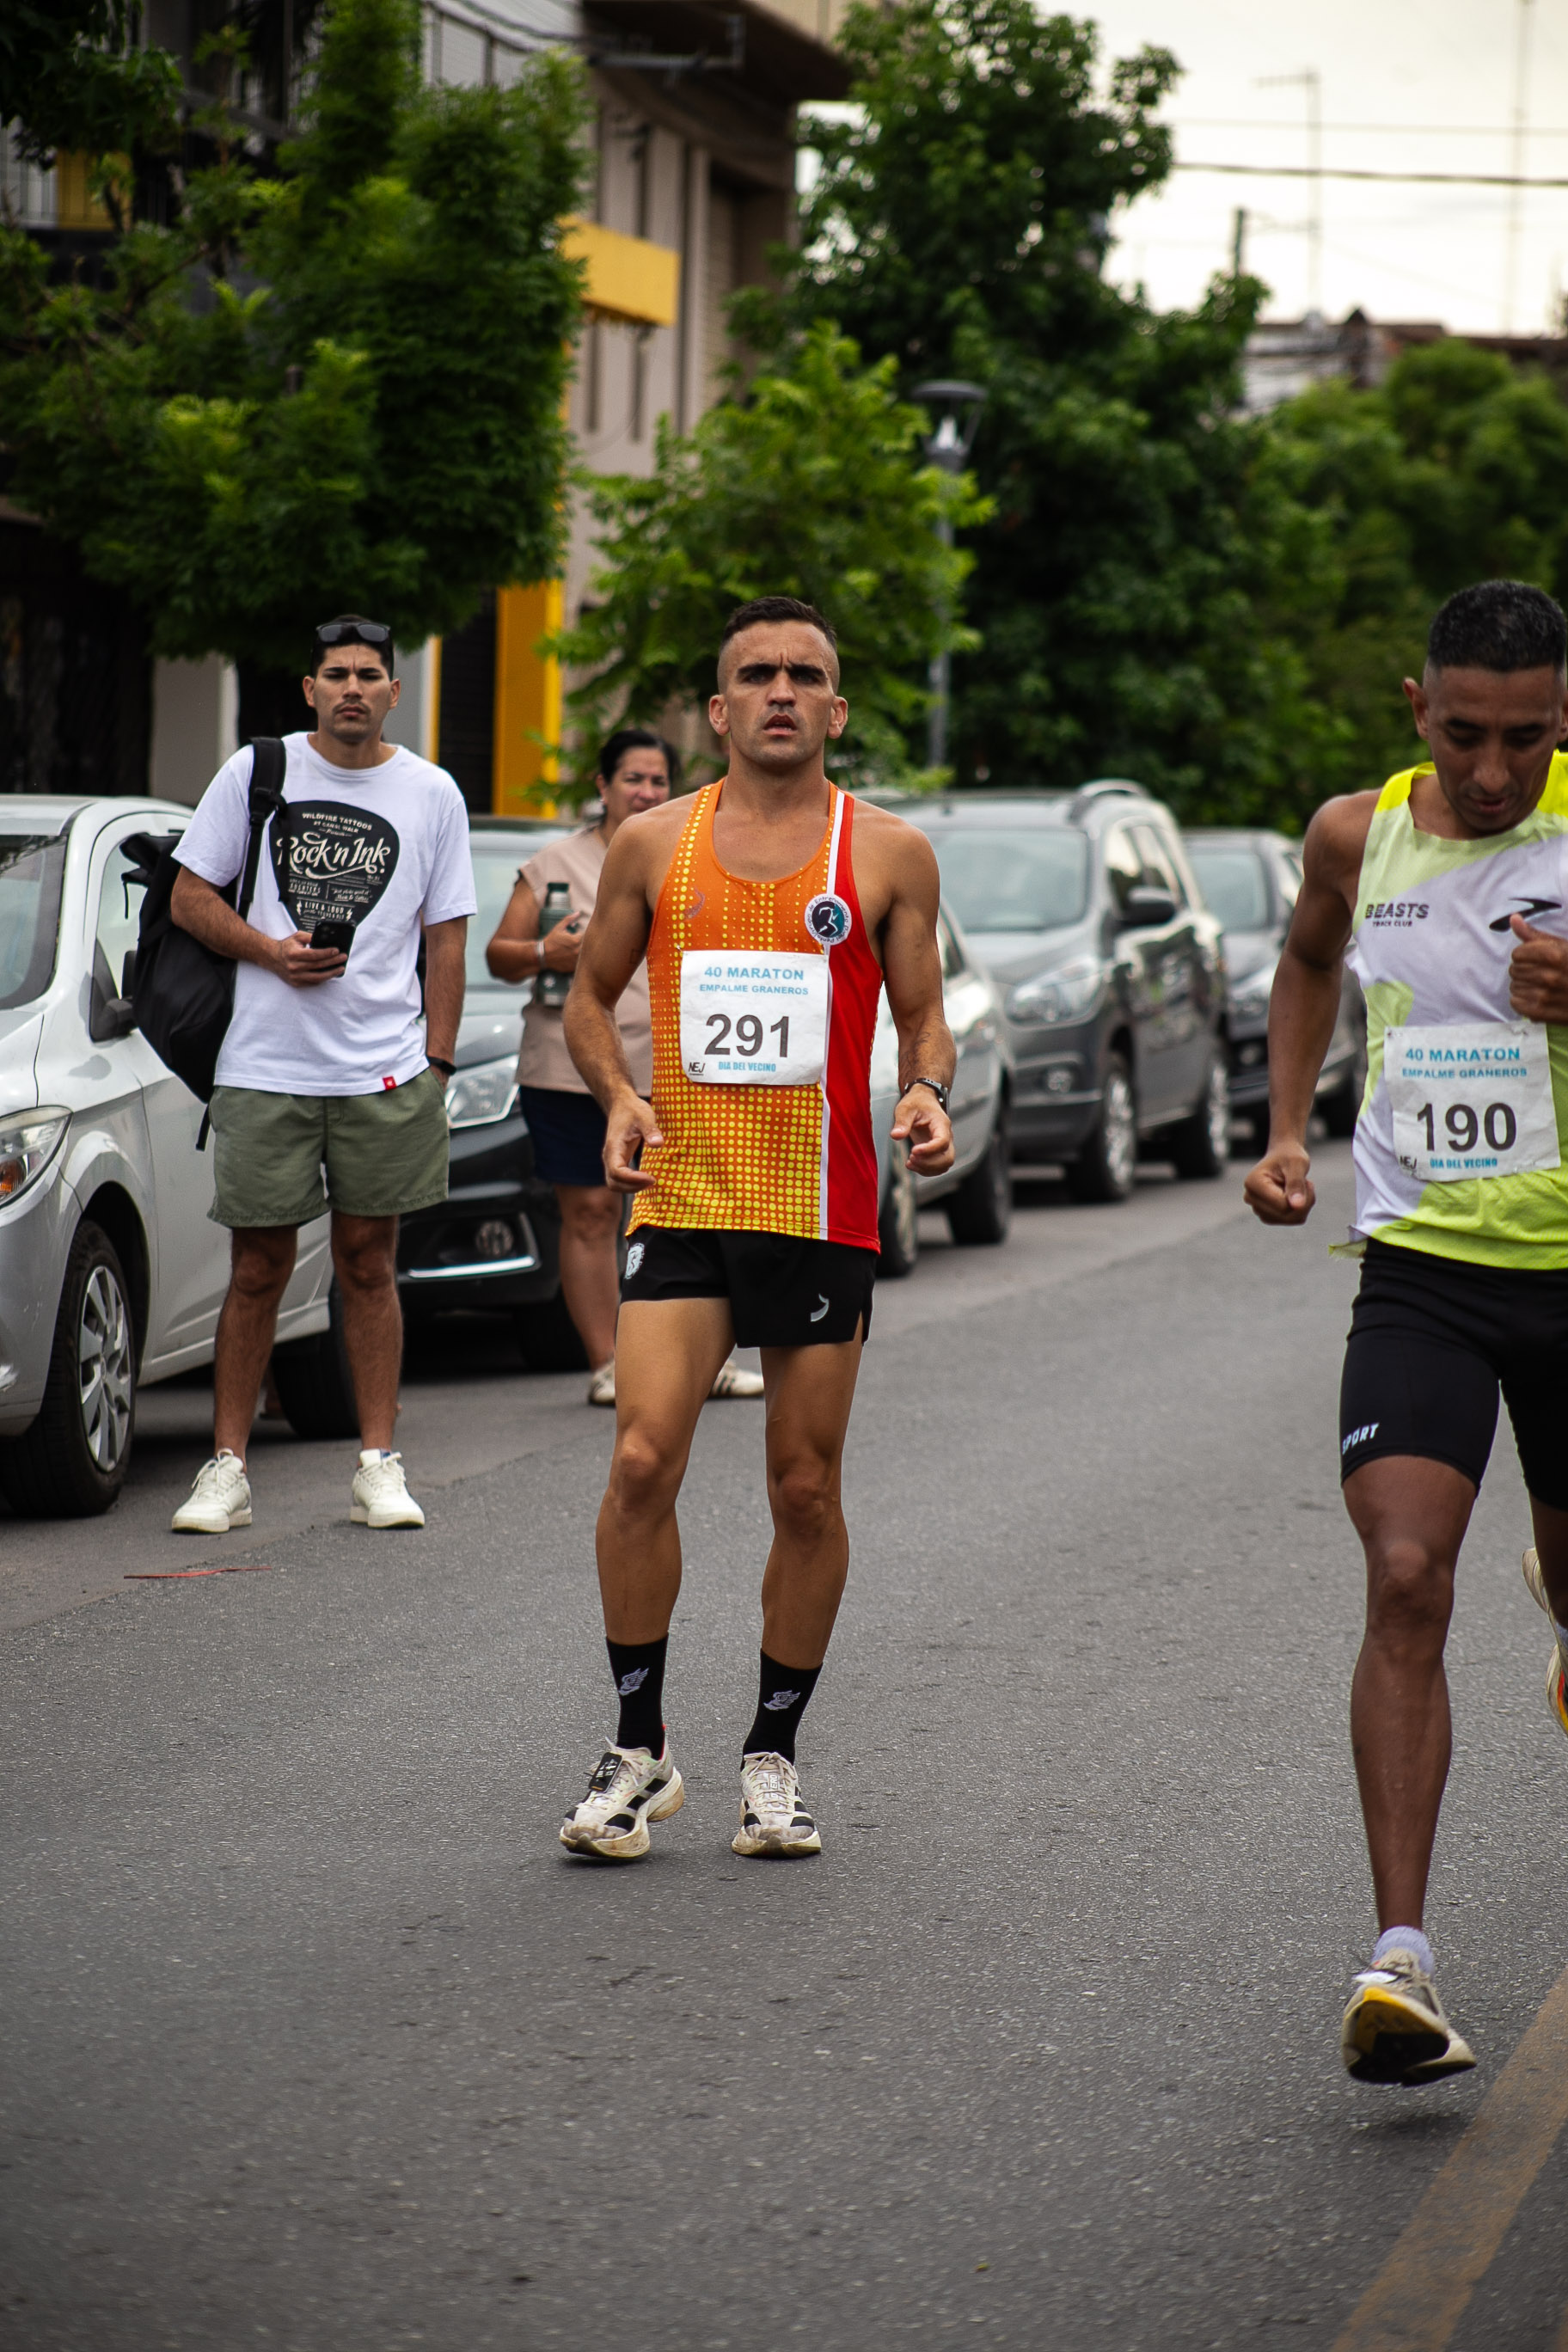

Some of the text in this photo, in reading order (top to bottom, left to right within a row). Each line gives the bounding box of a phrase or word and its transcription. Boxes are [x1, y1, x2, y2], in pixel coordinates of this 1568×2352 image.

[302, 812, 372, 830] WILDFIRE TATTOOS
[1364, 903, 1430, 919] BEASTS
[704, 966, 804, 980] 40 MARATON
[699, 984, 809, 995] EMPALME GRANEROS
[704, 1014, 789, 1058] 291
[1406, 1047, 1520, 1062] 40 MARATON
[719, 1061, 776, 1072] DIA DEL VECINO
[1402, 1068, 1527, 1078] EMPALME GRANEROS
[1417, 1102, 1516, 1152] 190
[1430, 1158, 1498, 1169] DIA DEL VECINO
